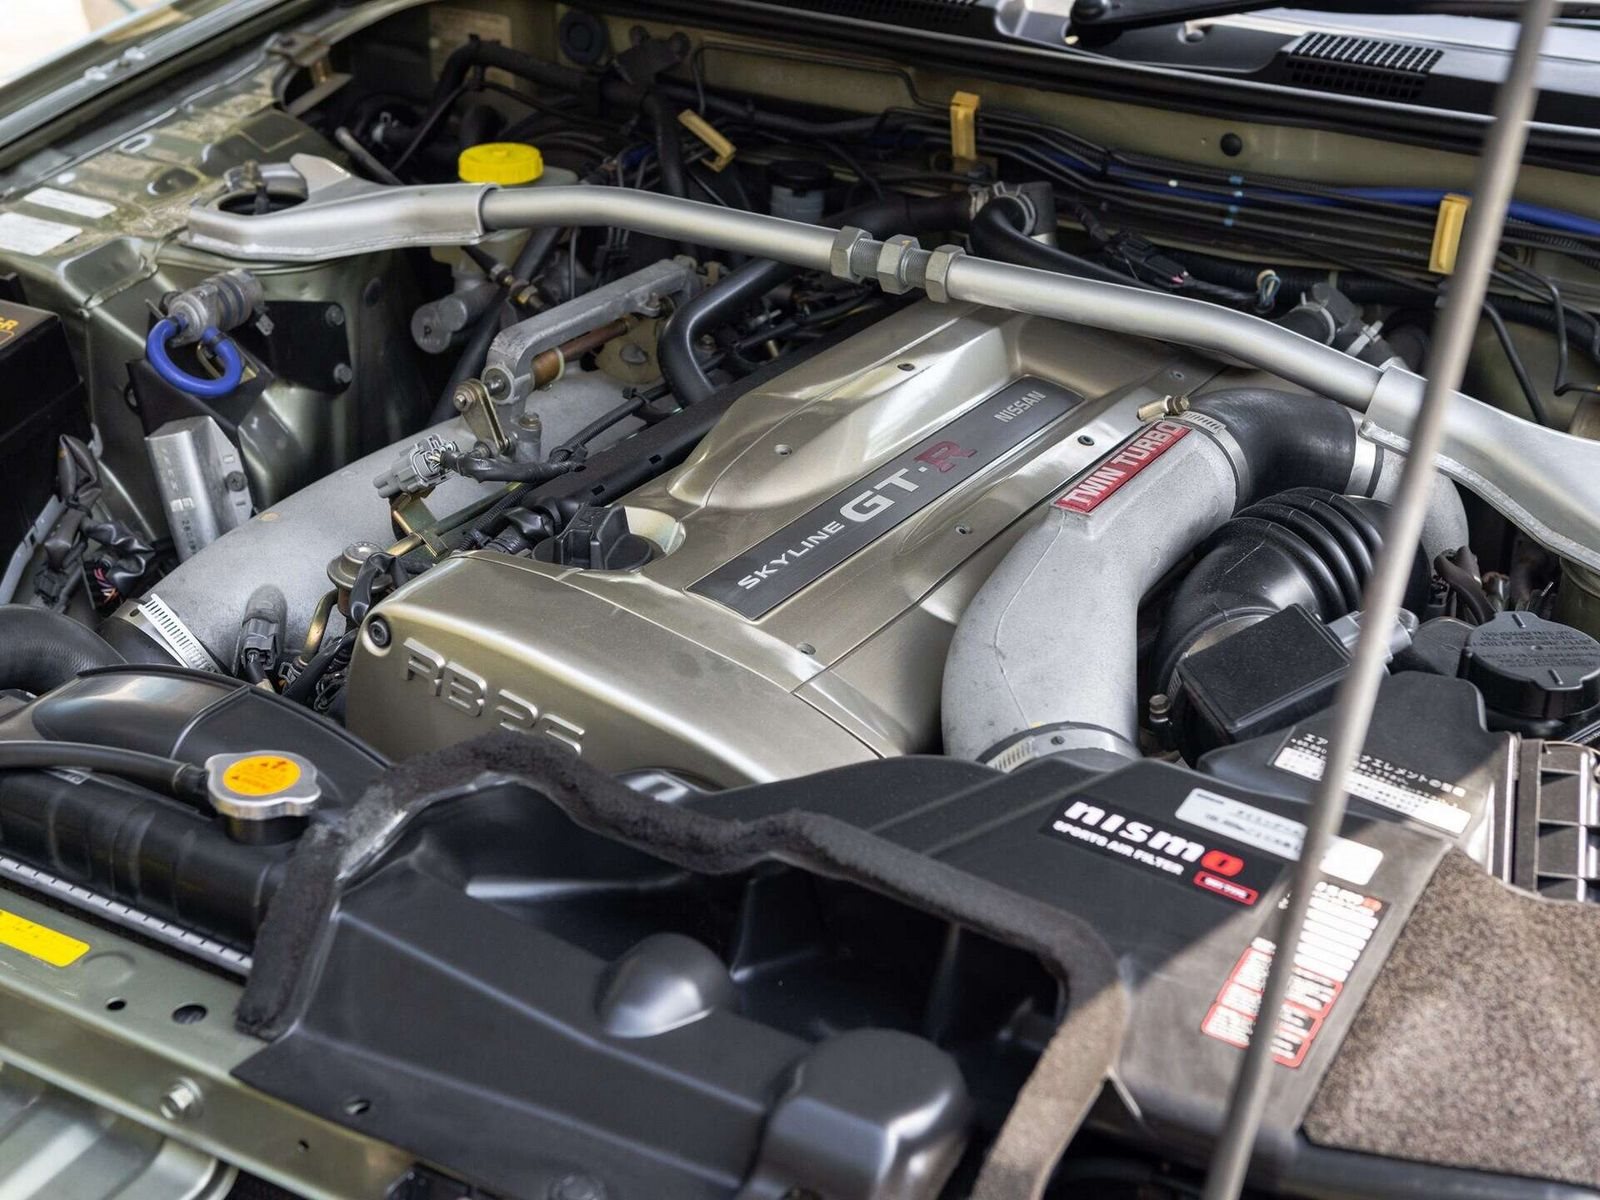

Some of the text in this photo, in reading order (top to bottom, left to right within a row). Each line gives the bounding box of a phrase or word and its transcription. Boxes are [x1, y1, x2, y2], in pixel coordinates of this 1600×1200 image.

[994, 391, 1047, 423] NISSAN
[1063, 420, 1185, 506] TWIN TURBO
[737, 521, 845, 590] SKYLINE
[1052, 820, 1184, 875] SPORTS AIR FILTER
[1064, 801, 1244, 876] nismo
